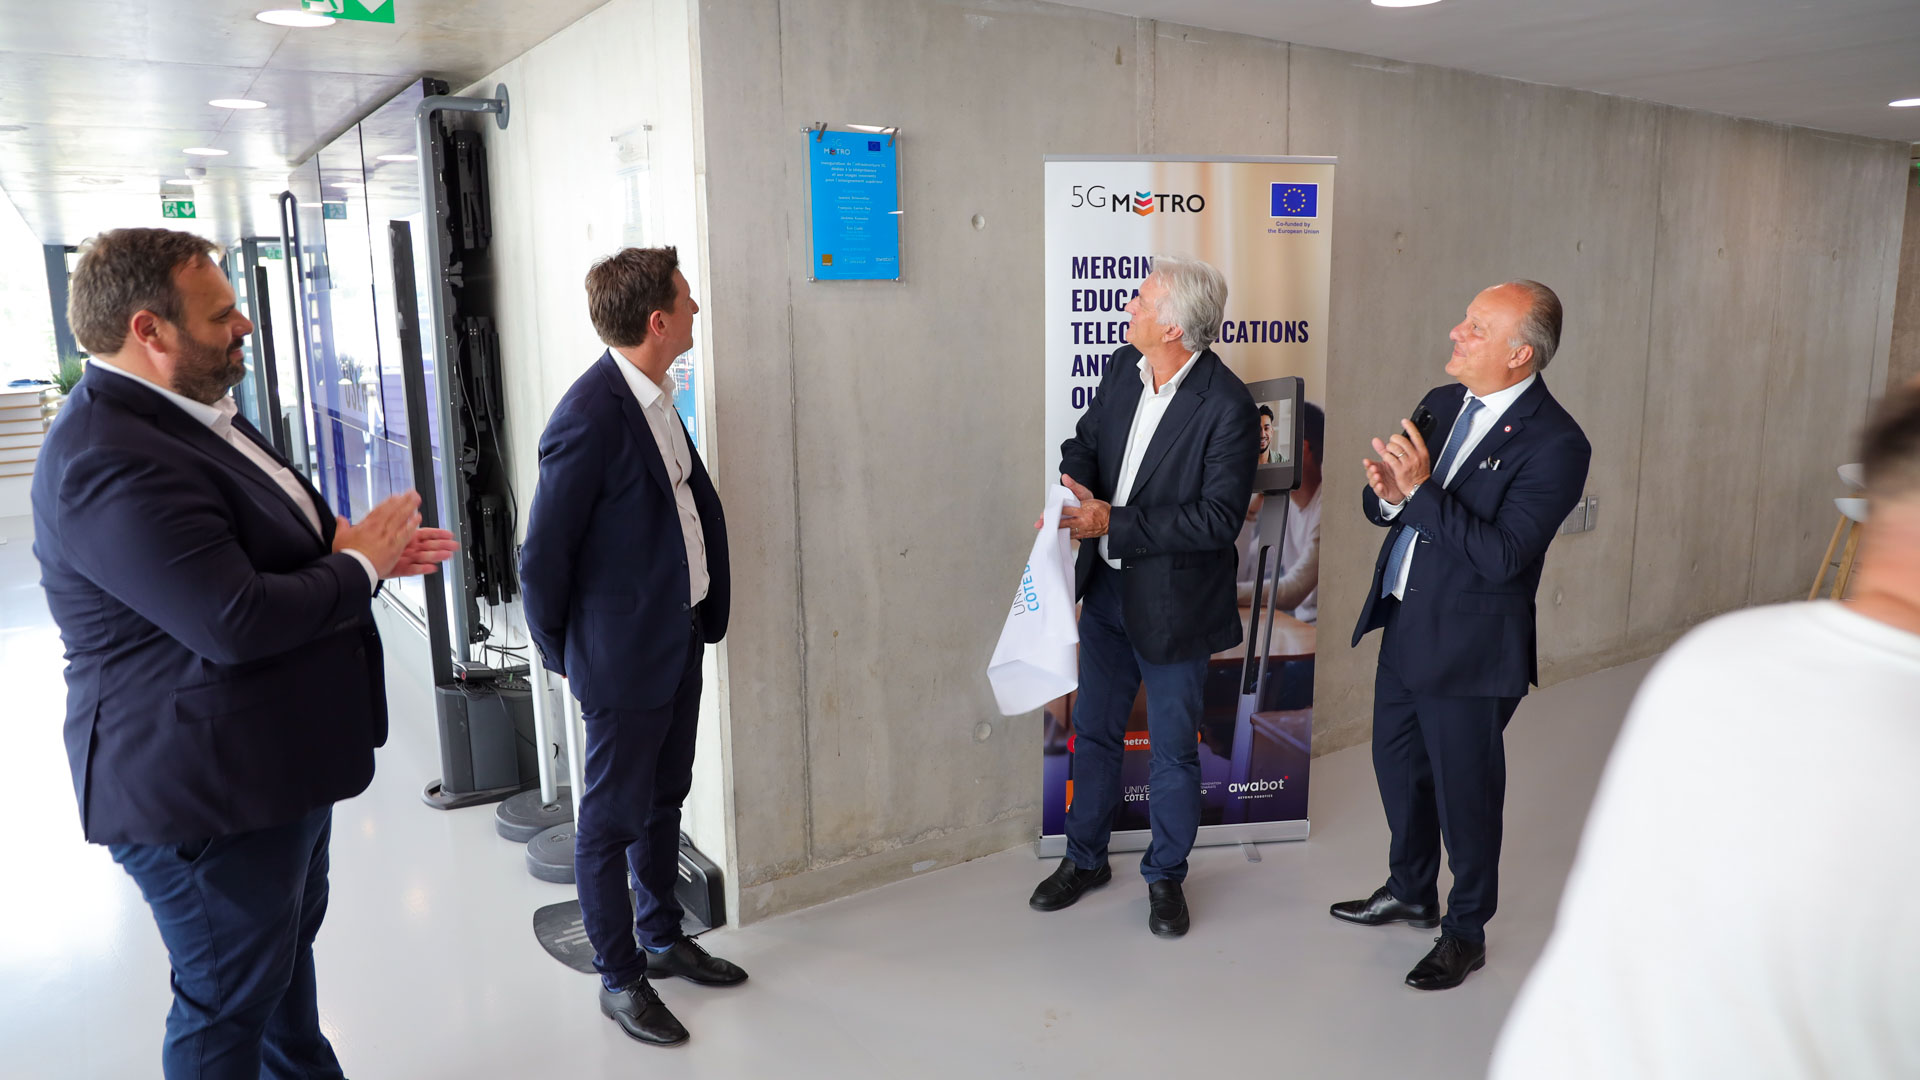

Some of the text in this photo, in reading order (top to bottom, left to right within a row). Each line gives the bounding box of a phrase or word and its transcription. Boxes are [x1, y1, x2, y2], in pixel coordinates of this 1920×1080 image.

[1071, 185, 1106, 208] 5G
[1071, 255, 1154, 279] MERGIN
[1124, 784, 1150, 794] UNIVE
[1228, 778, 1285, 793] awabot
